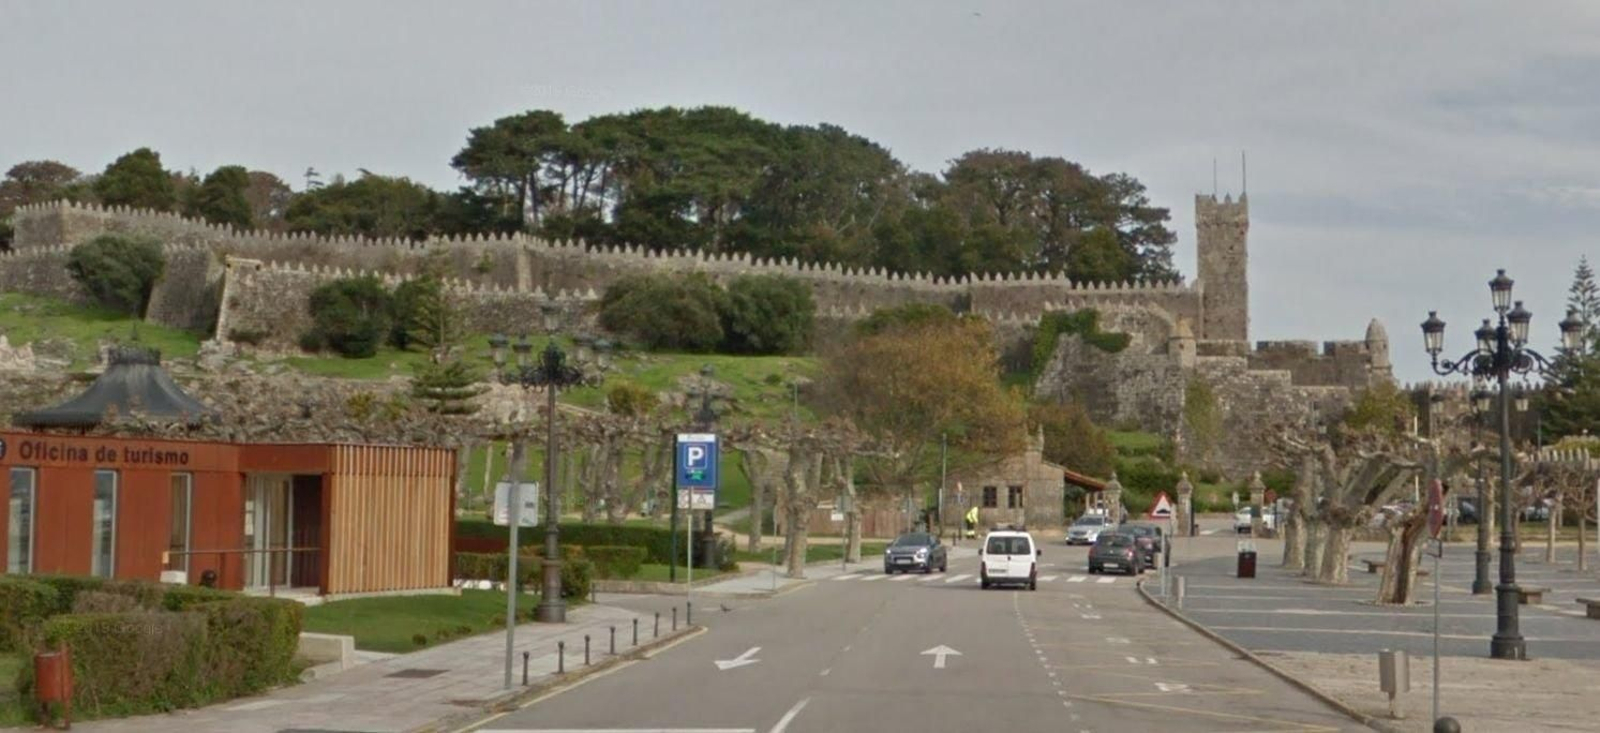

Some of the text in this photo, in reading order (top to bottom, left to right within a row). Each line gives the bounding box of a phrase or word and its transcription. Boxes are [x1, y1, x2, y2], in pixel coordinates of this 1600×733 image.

[19, 441, 189, 465] Oficina de turismo
[688, 446, 704, 466] P
